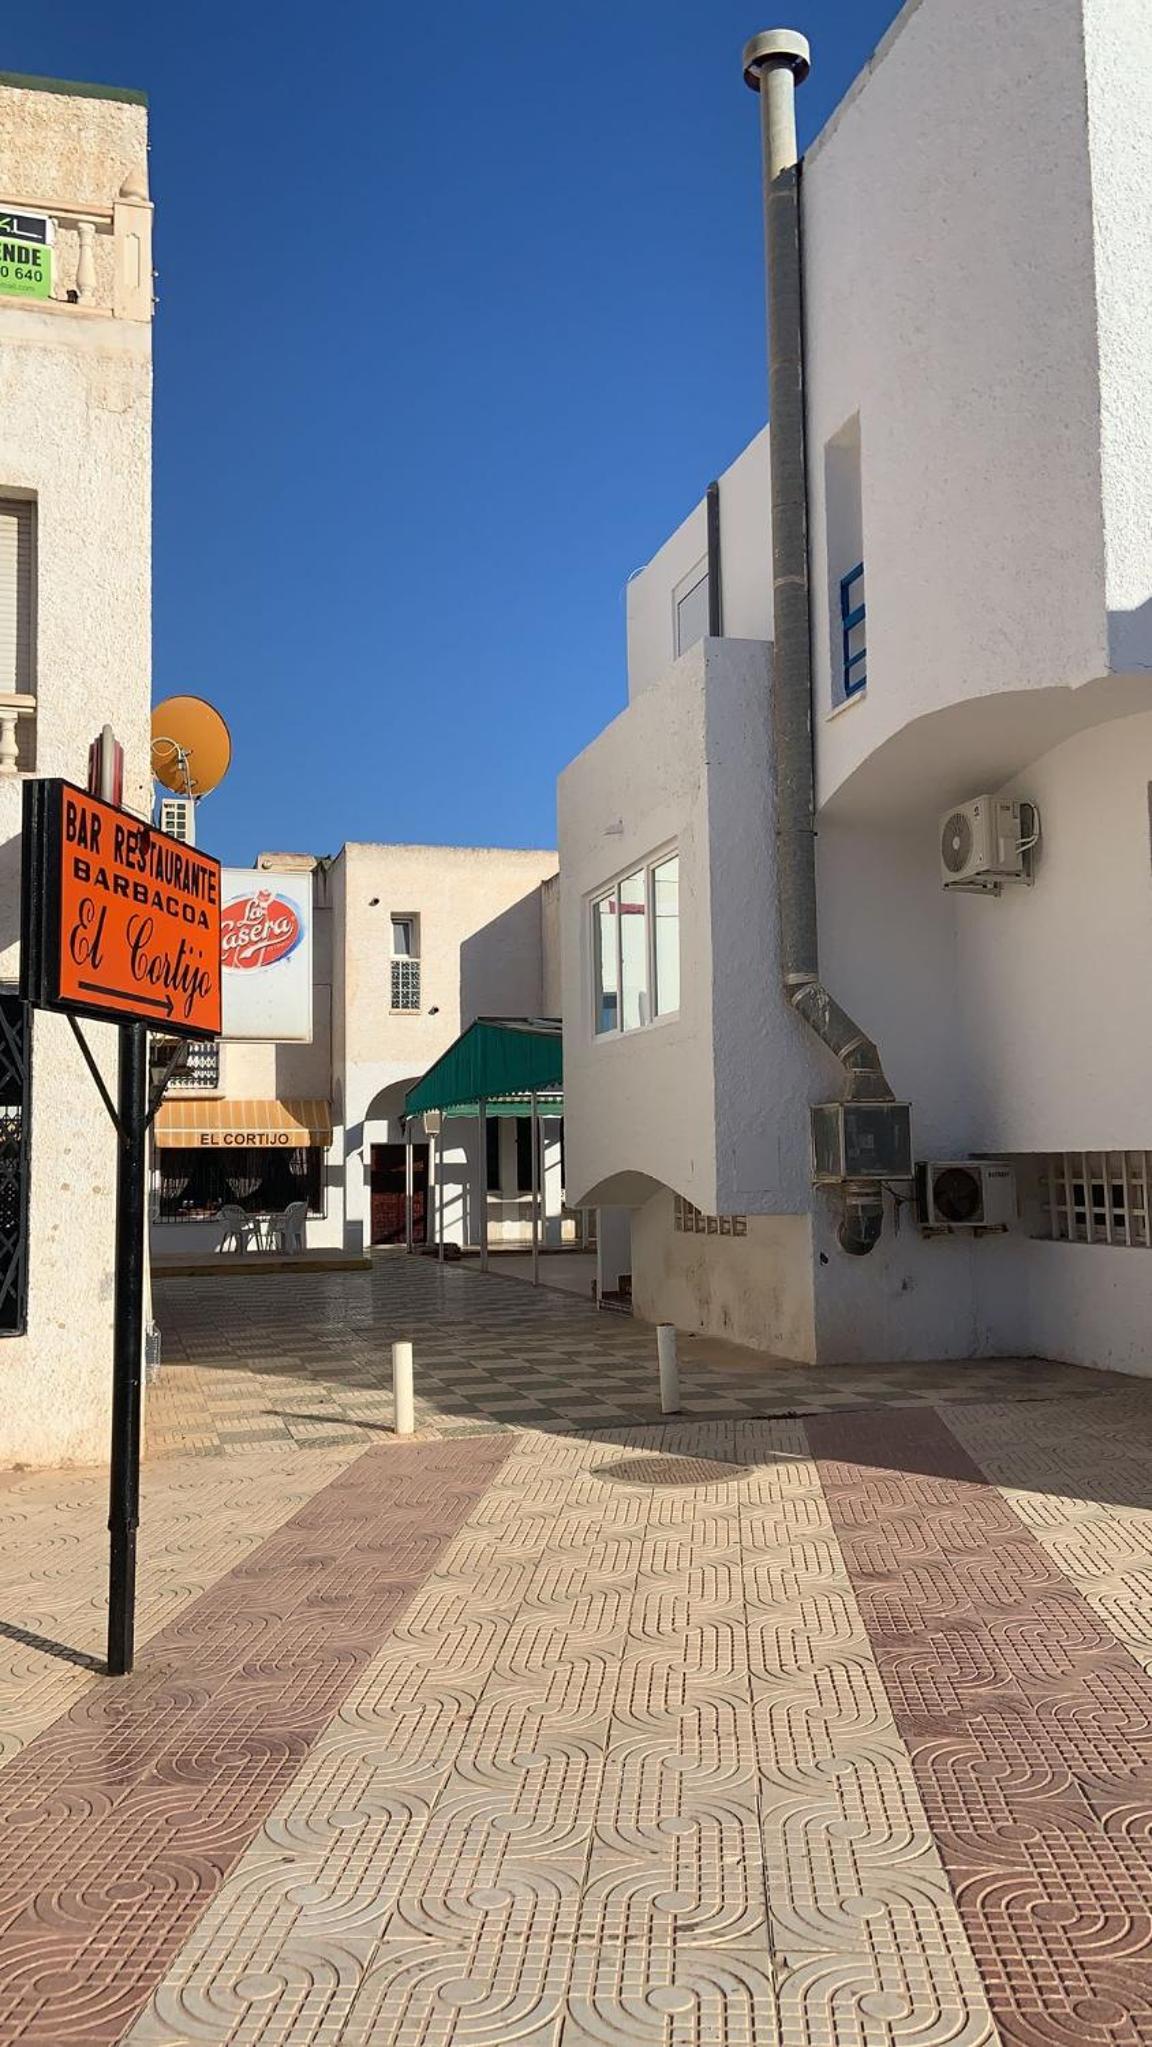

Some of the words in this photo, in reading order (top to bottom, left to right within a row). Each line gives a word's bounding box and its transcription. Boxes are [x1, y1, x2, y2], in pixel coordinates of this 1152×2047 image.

[0, 242, 41, 266] NDE
[15, 267, 43, 282] 640
[66, 801, 101, 855] BAR
[114, 824, 217, 906] RESTAURANTE
[74, 857, 209, 929] BARBACOA
[238, 899, 266, 926] La
[70, 898, 107, 970] El
[127, 913, 212, 1018] Cortijo
[200, 1134, 219, 1145] EL
[223, 1133, 289, 1146] CORTIJO
